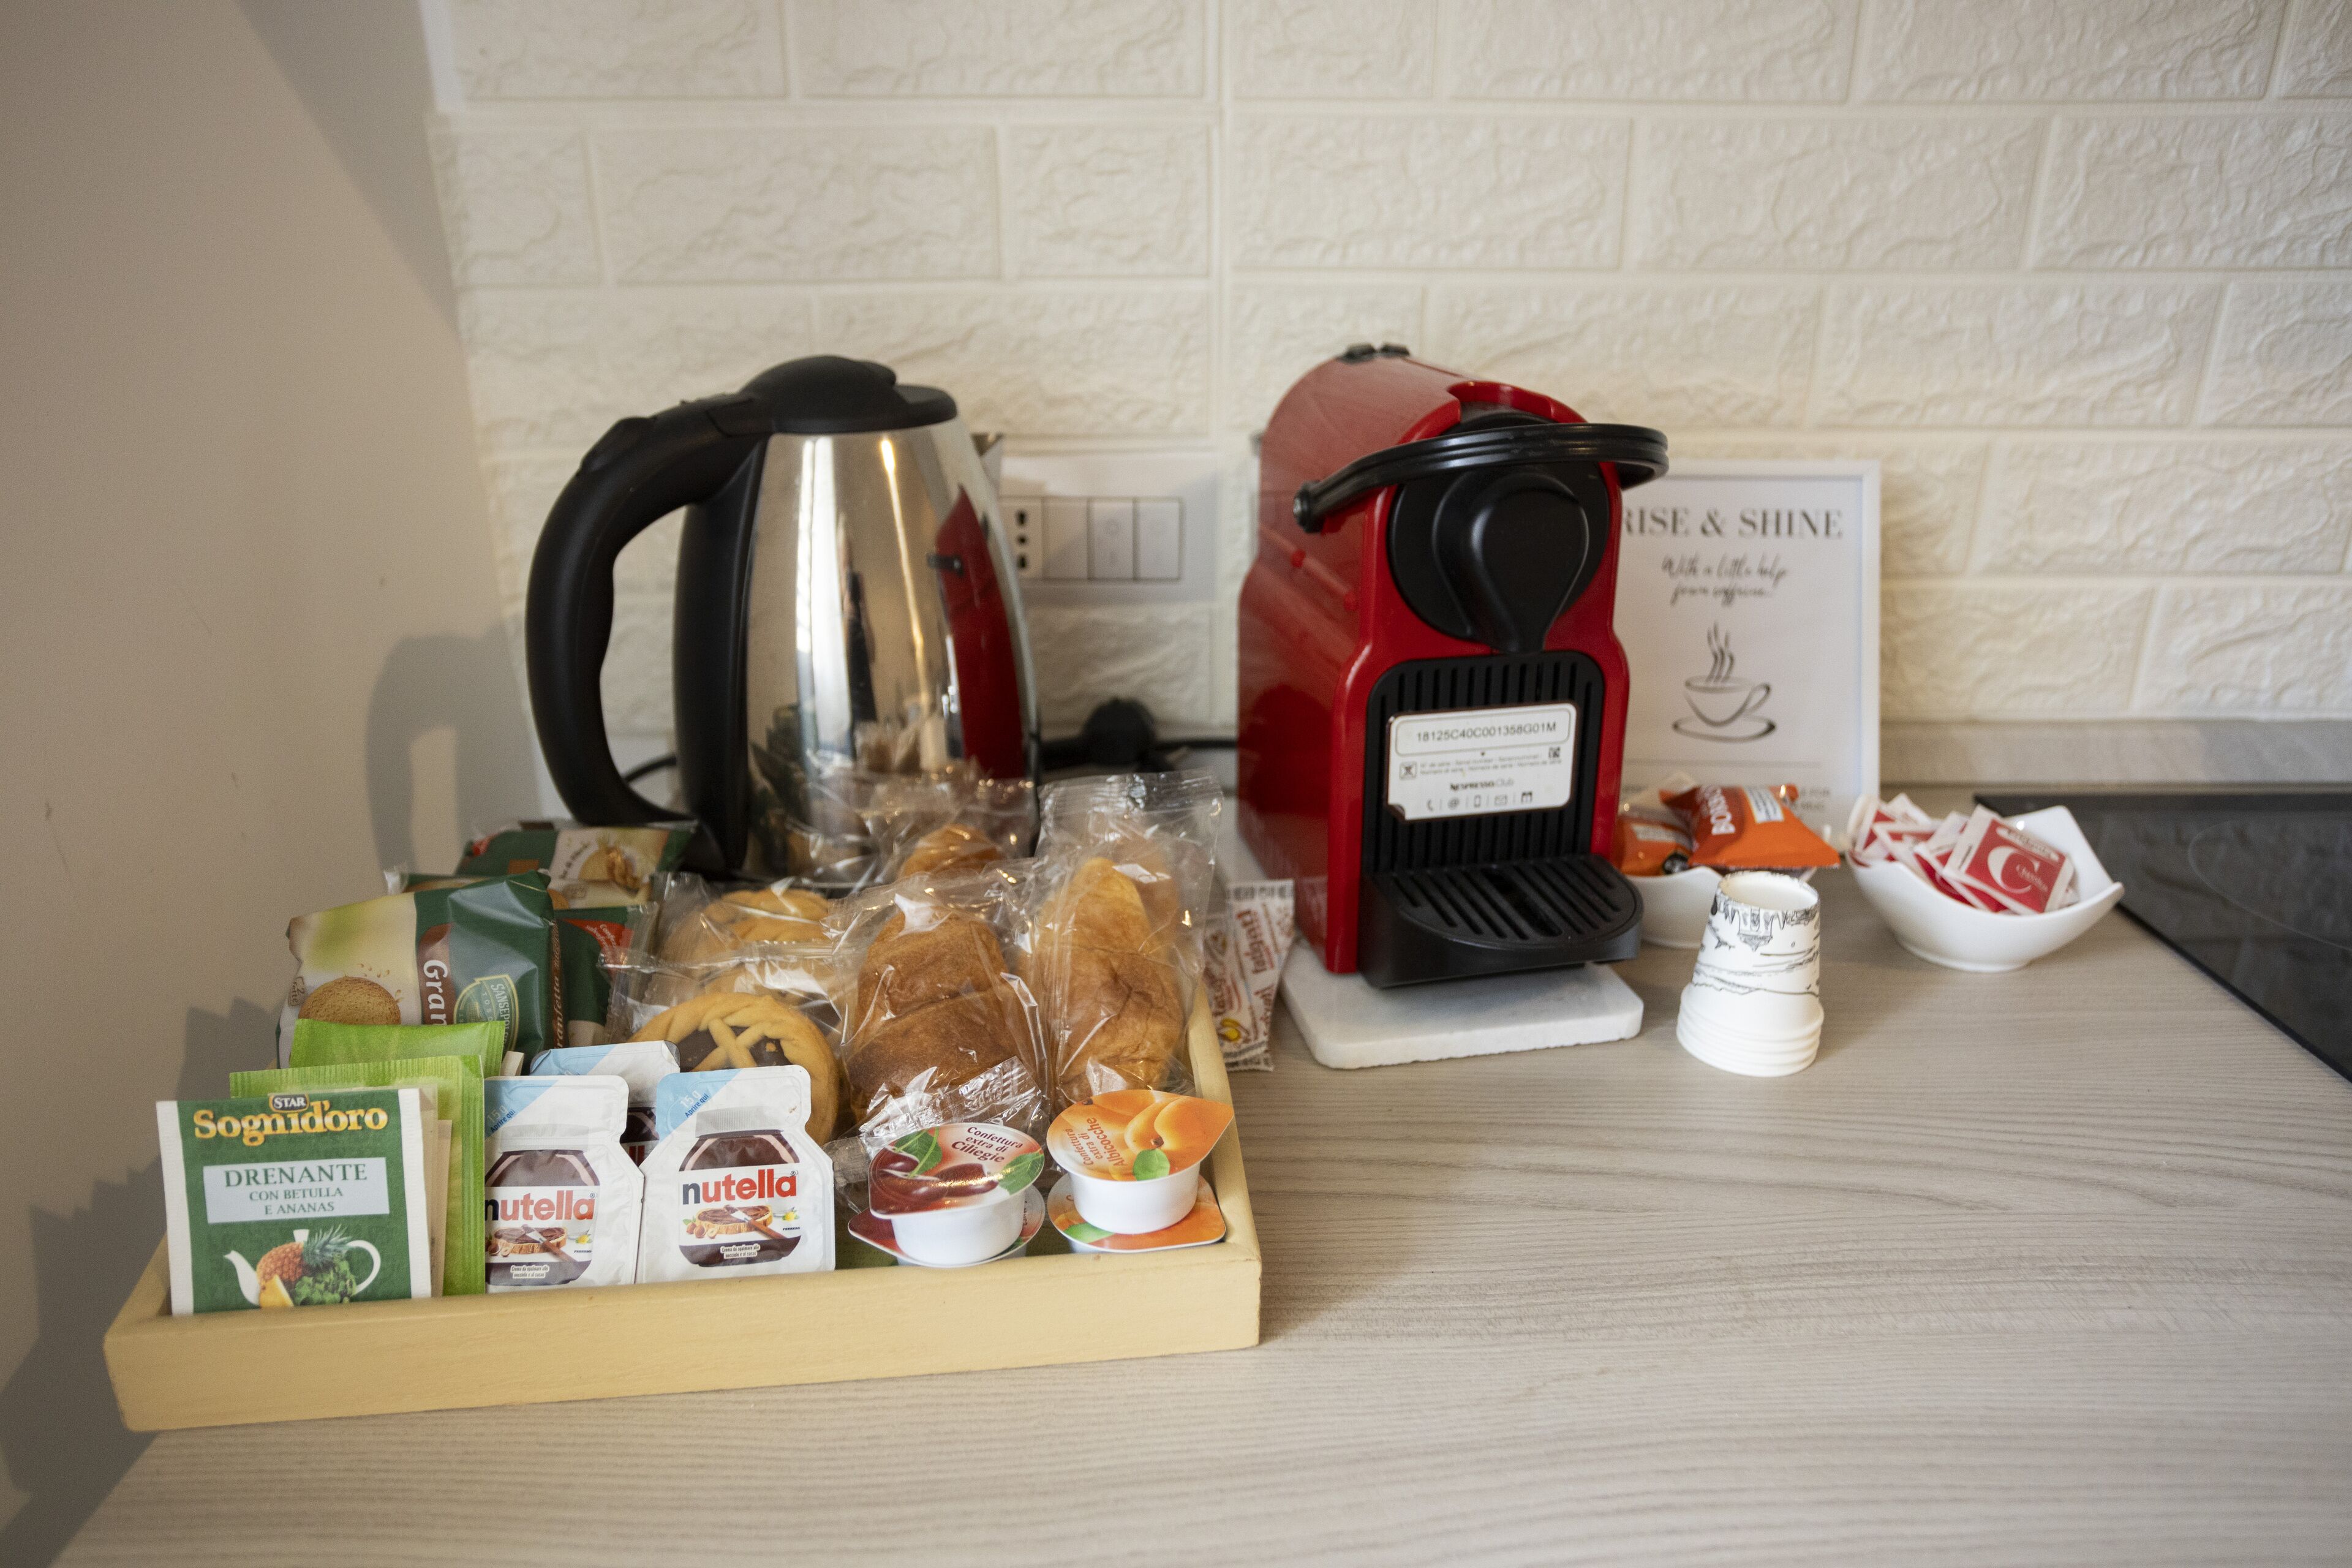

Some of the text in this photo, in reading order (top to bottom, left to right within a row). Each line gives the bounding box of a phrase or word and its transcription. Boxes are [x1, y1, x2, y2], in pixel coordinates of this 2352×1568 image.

[1700, 508, 1723, 537] &
[1738, 508, 1843, 539] SHINE
[273, 1095, 306, 1109] STAR
[680, 1095, 694, 1110] 15
[685, 1093, 709, 1118] Aprire qui
[490, 1108, 516, 1133] Aprire qui
[965, 1137, 1009, 1153] extra di
[967, 1126, 1023, 1149] Confettura
[1066, 1128, 1094, 1166] Confettura
[1078, 1133, 1103, 1160] extra di
[1086, 1116, 1127, 1167] Albicocche
[951, 1140, 1005, 1163] Ciliegie
[224, 1164, 368, 1188] DRENANTE
[682, 1168, 797, 1205] nutella
[249, 1186, 344, 1201] CON BETULLA
[485, 1189, 596, 1221] nutella
[265, 1200, 335, 1215] E ANANAS
